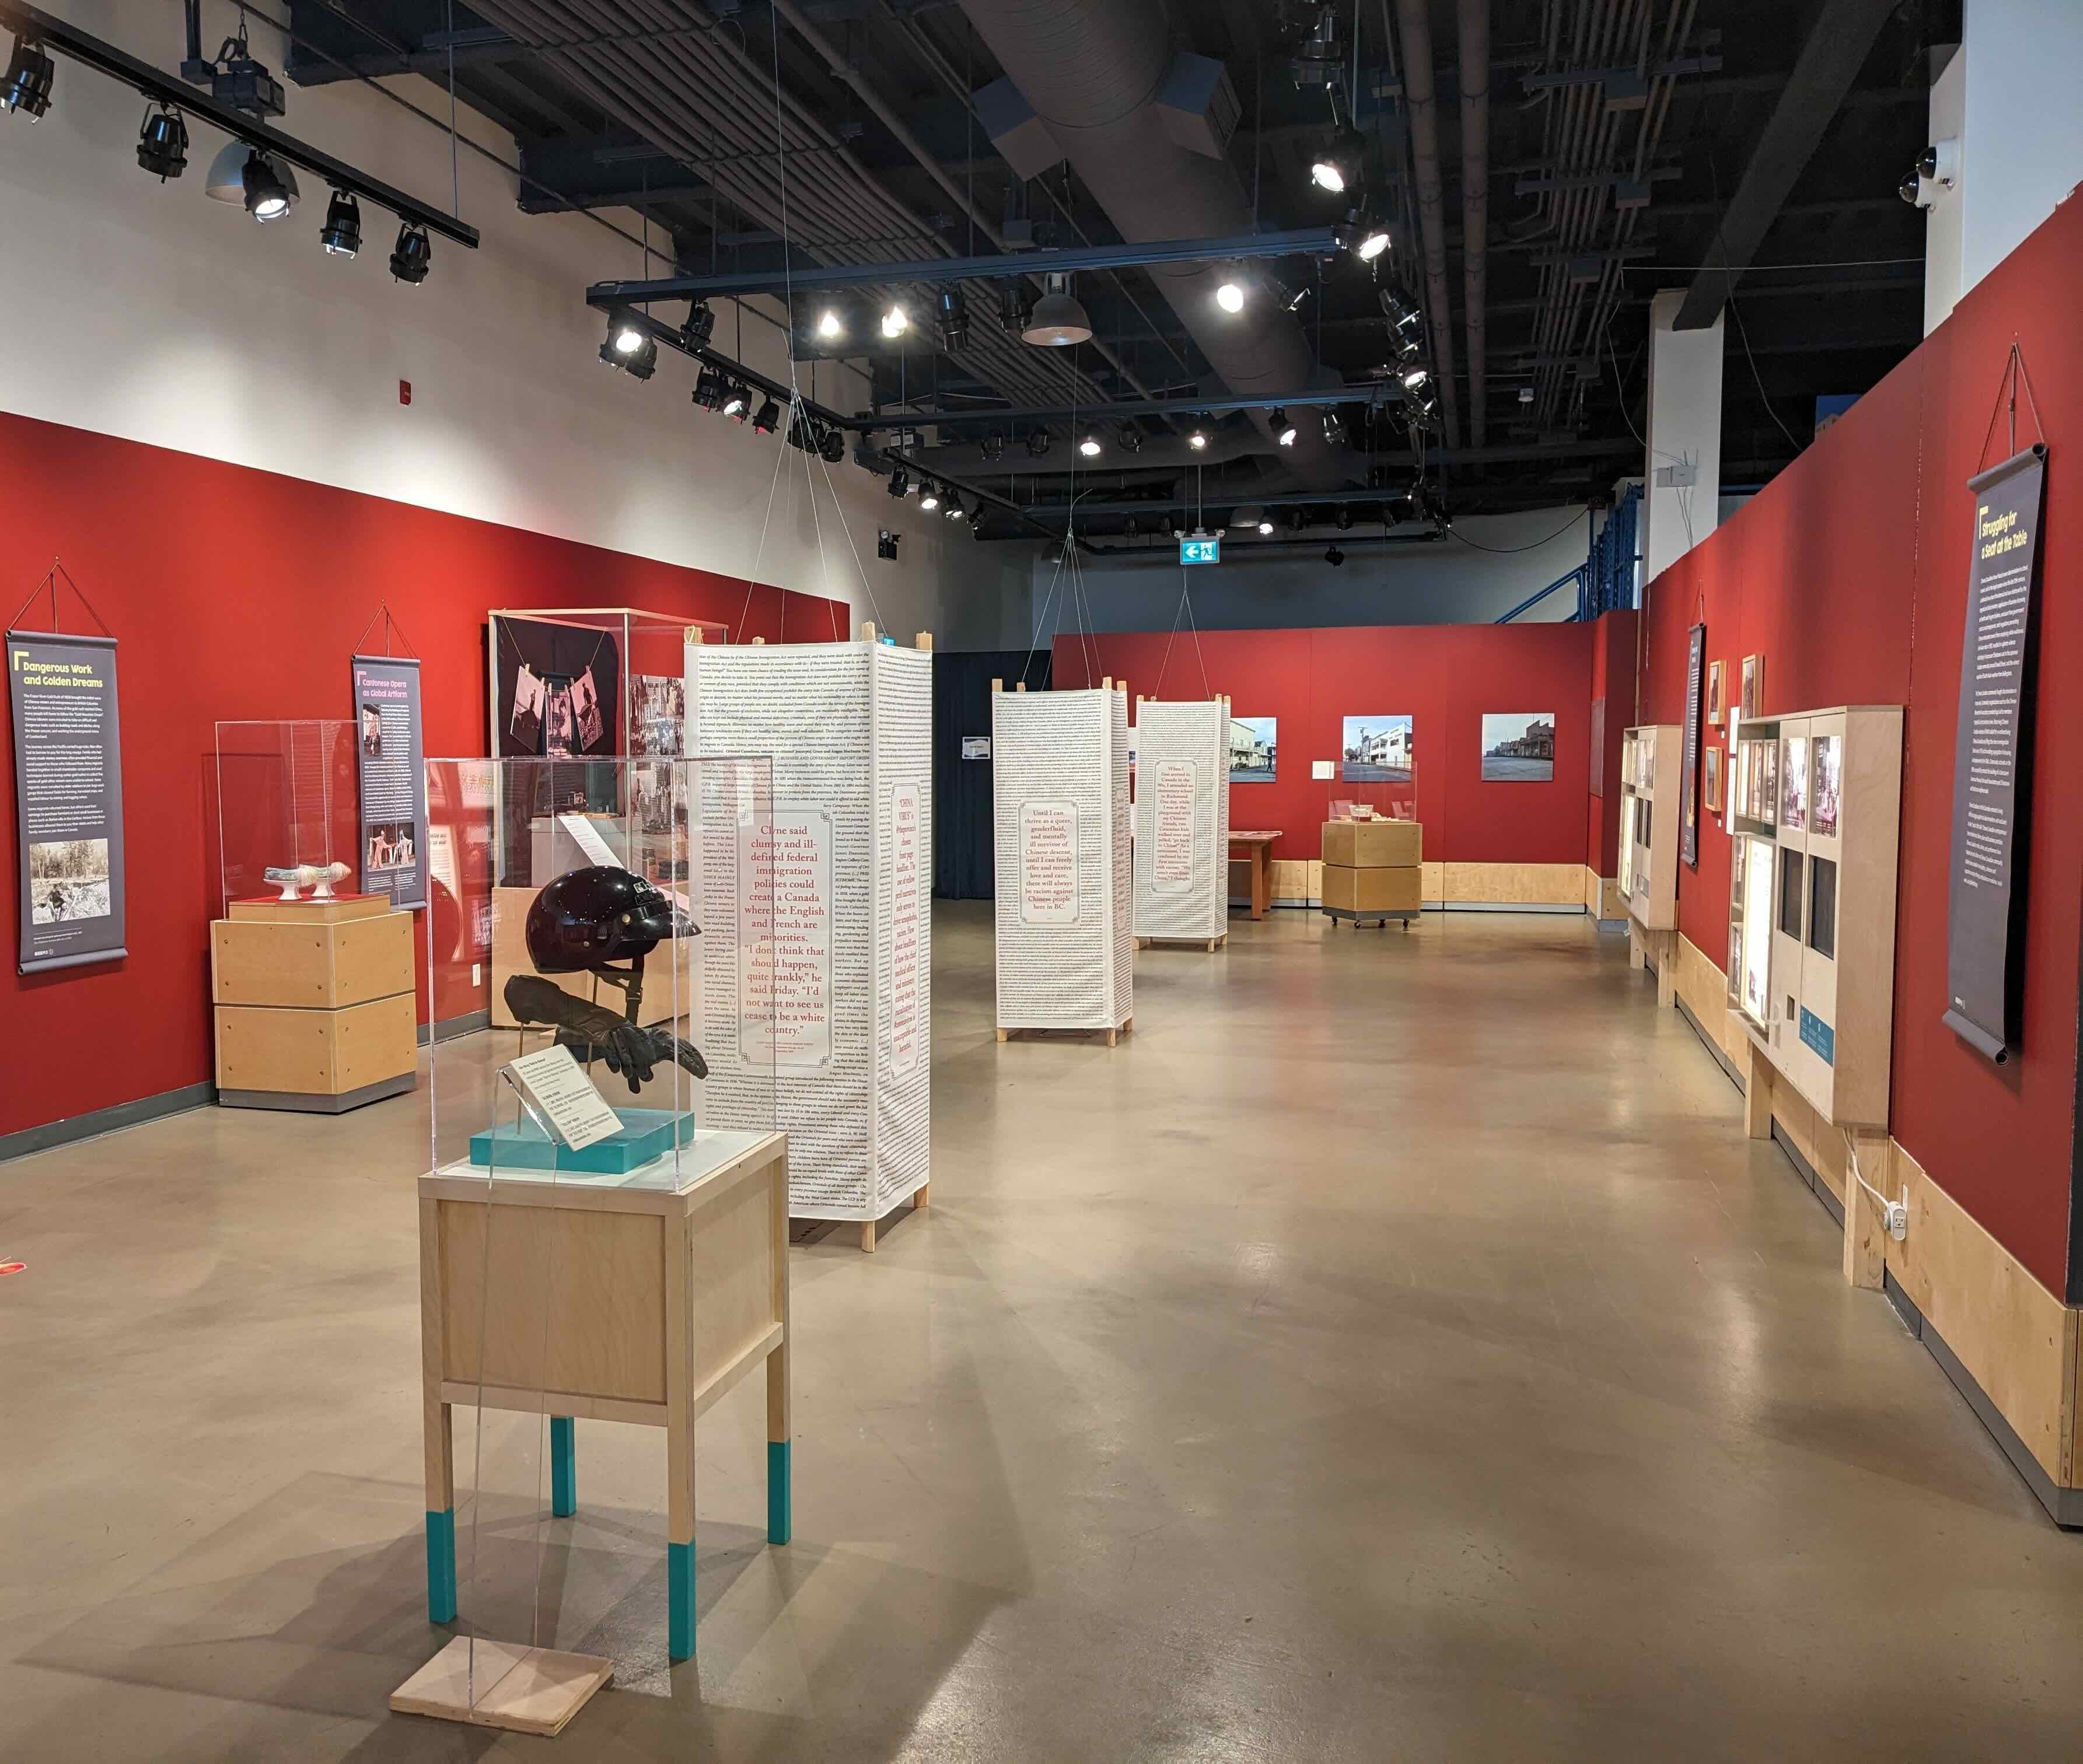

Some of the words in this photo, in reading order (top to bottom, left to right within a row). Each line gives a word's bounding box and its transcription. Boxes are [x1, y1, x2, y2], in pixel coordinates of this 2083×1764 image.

[1983, 514, 2008, 537] Struggling
[1981, 547, 1984, 559] a
[1985, 541, 1997, 558] Seat
[1997, 538, 2003, 554] at
[2013, 529, 2027, 548] Table
[23, 662, 69, 673] Dangerous
[71, 665, 92, 674] Work
[24, 676, 41, 685] and
[43, 677, 71, 686] Golden
[73, 678, 103, 687] Dreams
[789, 826, 808, 834] said
[752, 839, 782, 850] clumsy
[784, 839, 801, 848] and
[804, 840, 817, 848] ill-
[787, 853, 817, 862] federal
[756, 866, 812, 877] immigration
[789, 880, 814, 888] could
[785, 892, 819, 902] Canada
[745, 905, 770, 914] where
[790, 906, 824, 918] English
[745, 945, 752, 953] “I
[780, 946, 803, 955] think
[806, 947, 824, 955] that
[752, 958, 779, 967] shoud
[782, 959, 817, 971] happen,
[747, 972, 768, 982] quite
[812, 974, 822, 982] he
[750, 985, 767, 993] said
[780, 1012, 789, 1020] be
[801, 1013, 824, 1022] white
